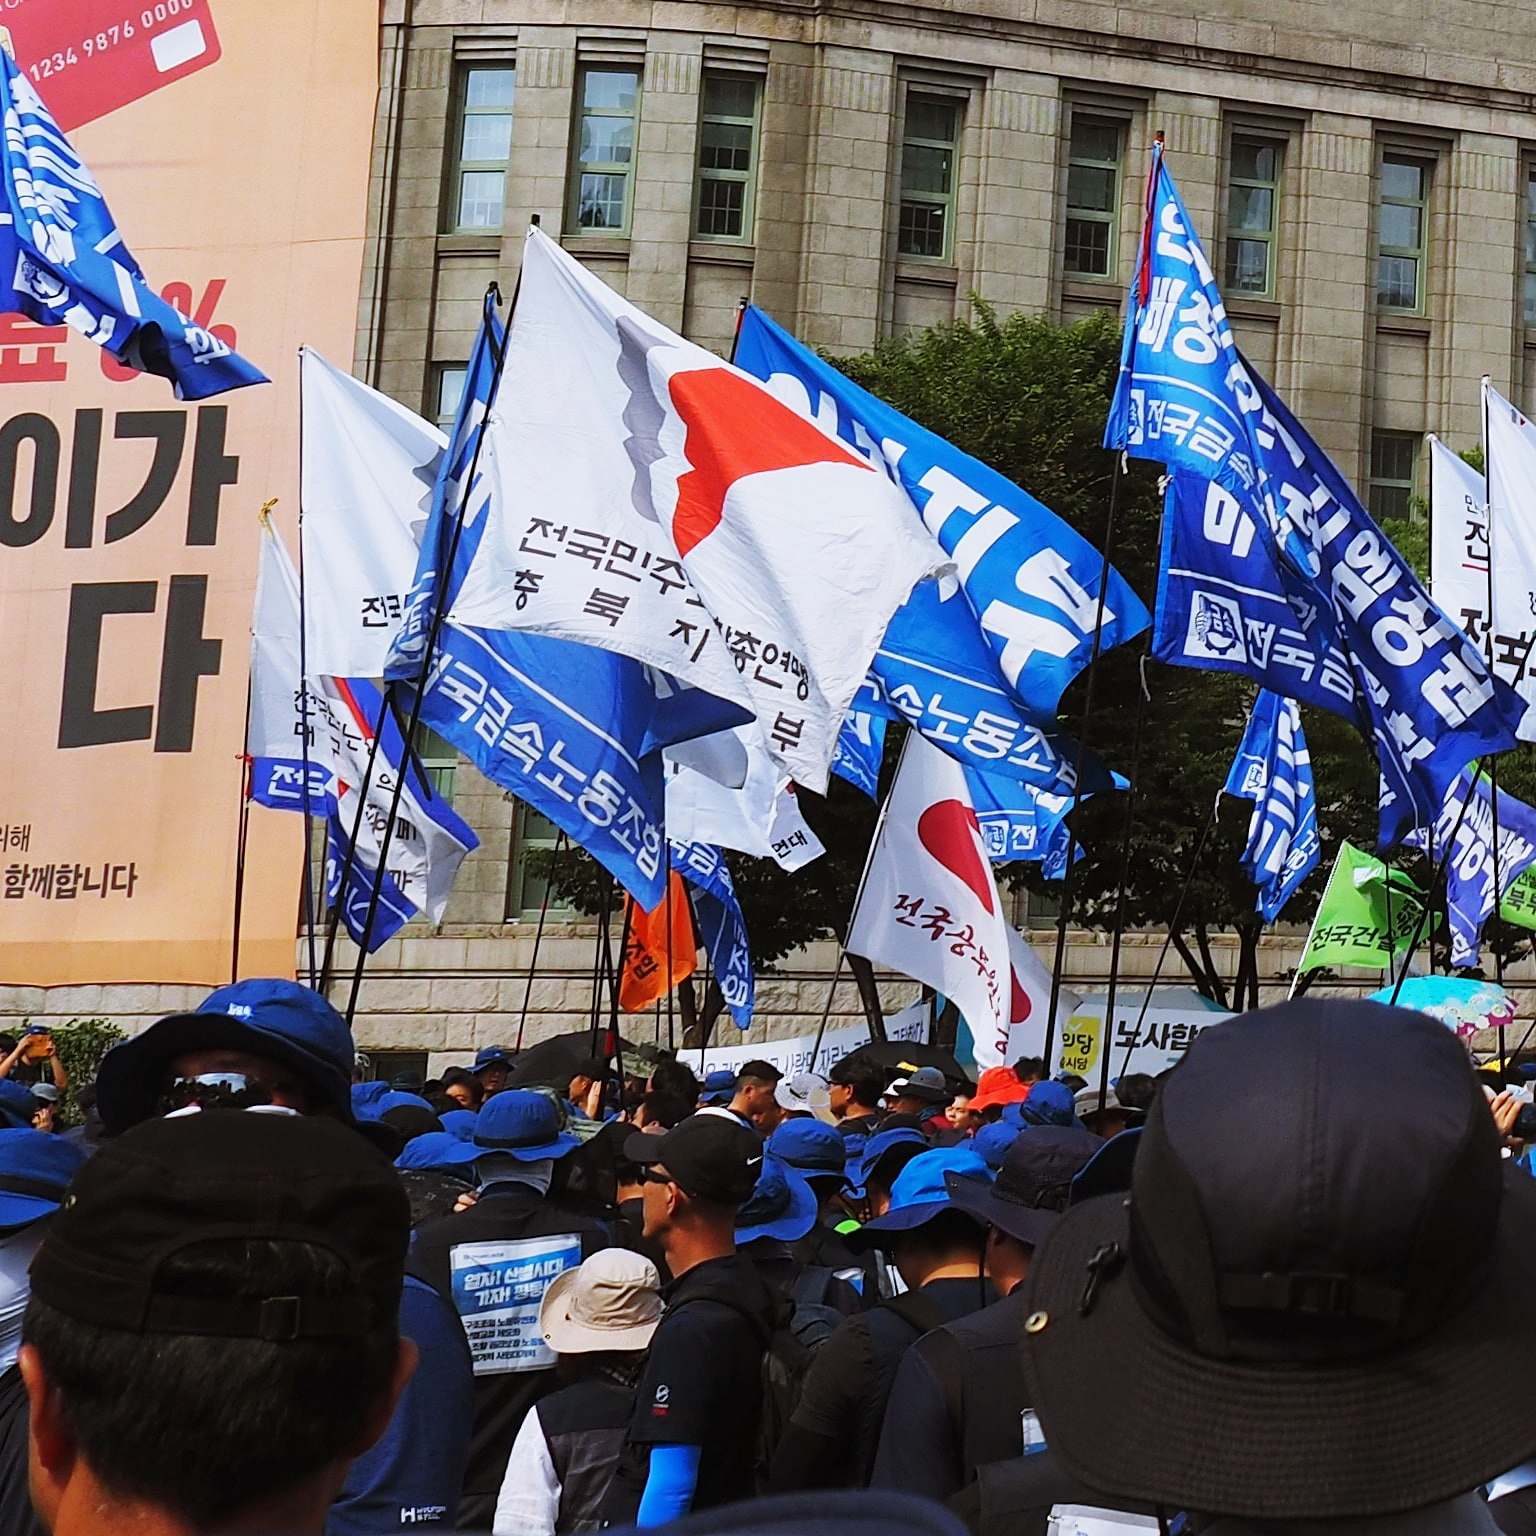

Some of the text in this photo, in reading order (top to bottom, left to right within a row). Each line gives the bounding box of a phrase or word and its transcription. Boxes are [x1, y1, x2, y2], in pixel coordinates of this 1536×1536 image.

[29, 48, 79, 83] 1234
[82, 20, 136, 60] 9876
[57, 573, 223, 753] 다
[4, 862, 139, 900] 함께합니다
[1062, 1033, 1094, 1055] 의당
